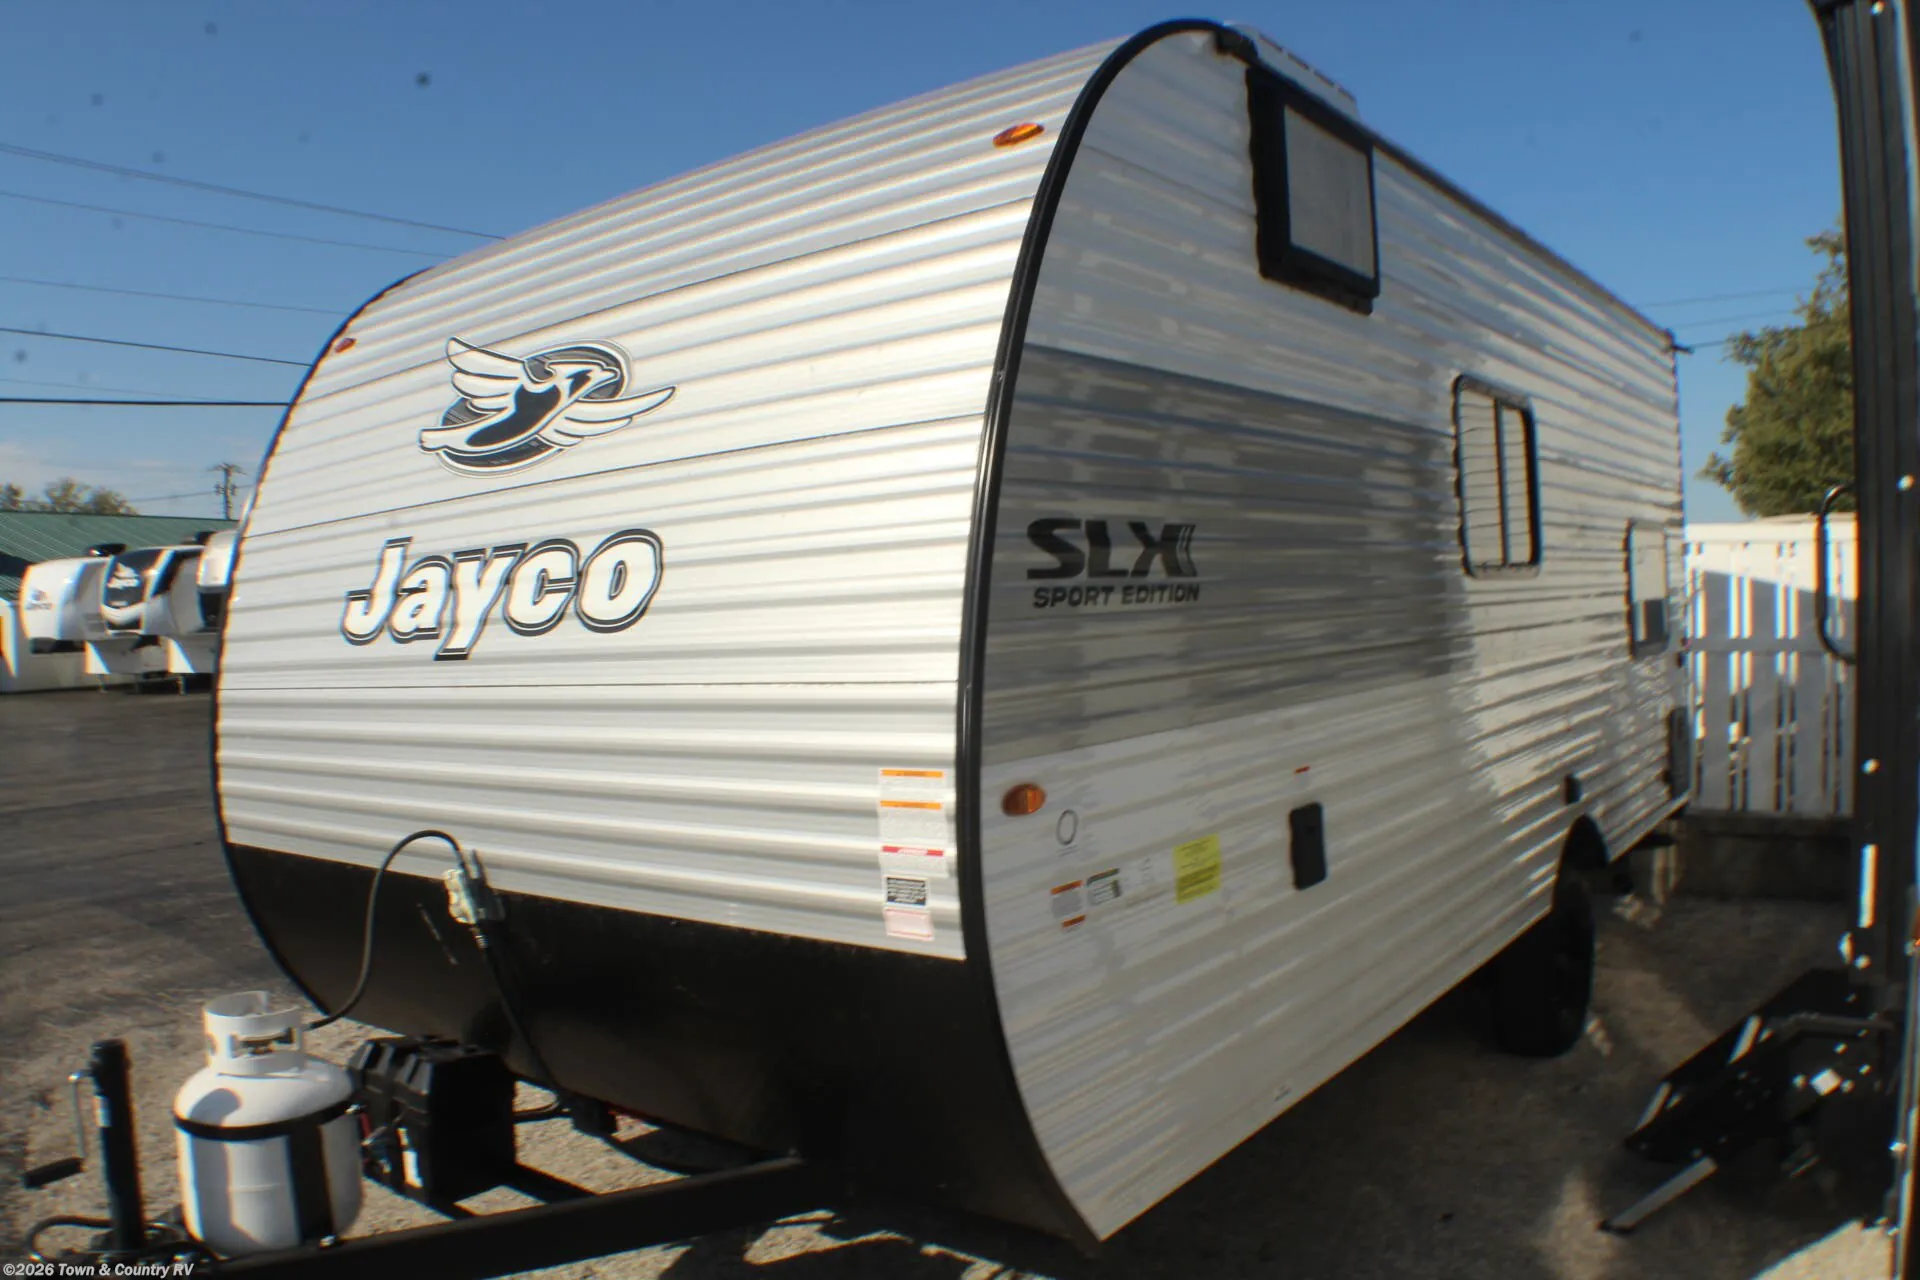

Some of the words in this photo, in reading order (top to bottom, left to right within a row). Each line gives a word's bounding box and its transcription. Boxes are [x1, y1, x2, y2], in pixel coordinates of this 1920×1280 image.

[1026, 517, 1198, 580] SLX
[340, 528, 664, 661] Jayco
[1033, 585, 1115, 609] SPORT
[1121, 583, 1200, 605] EDITION
